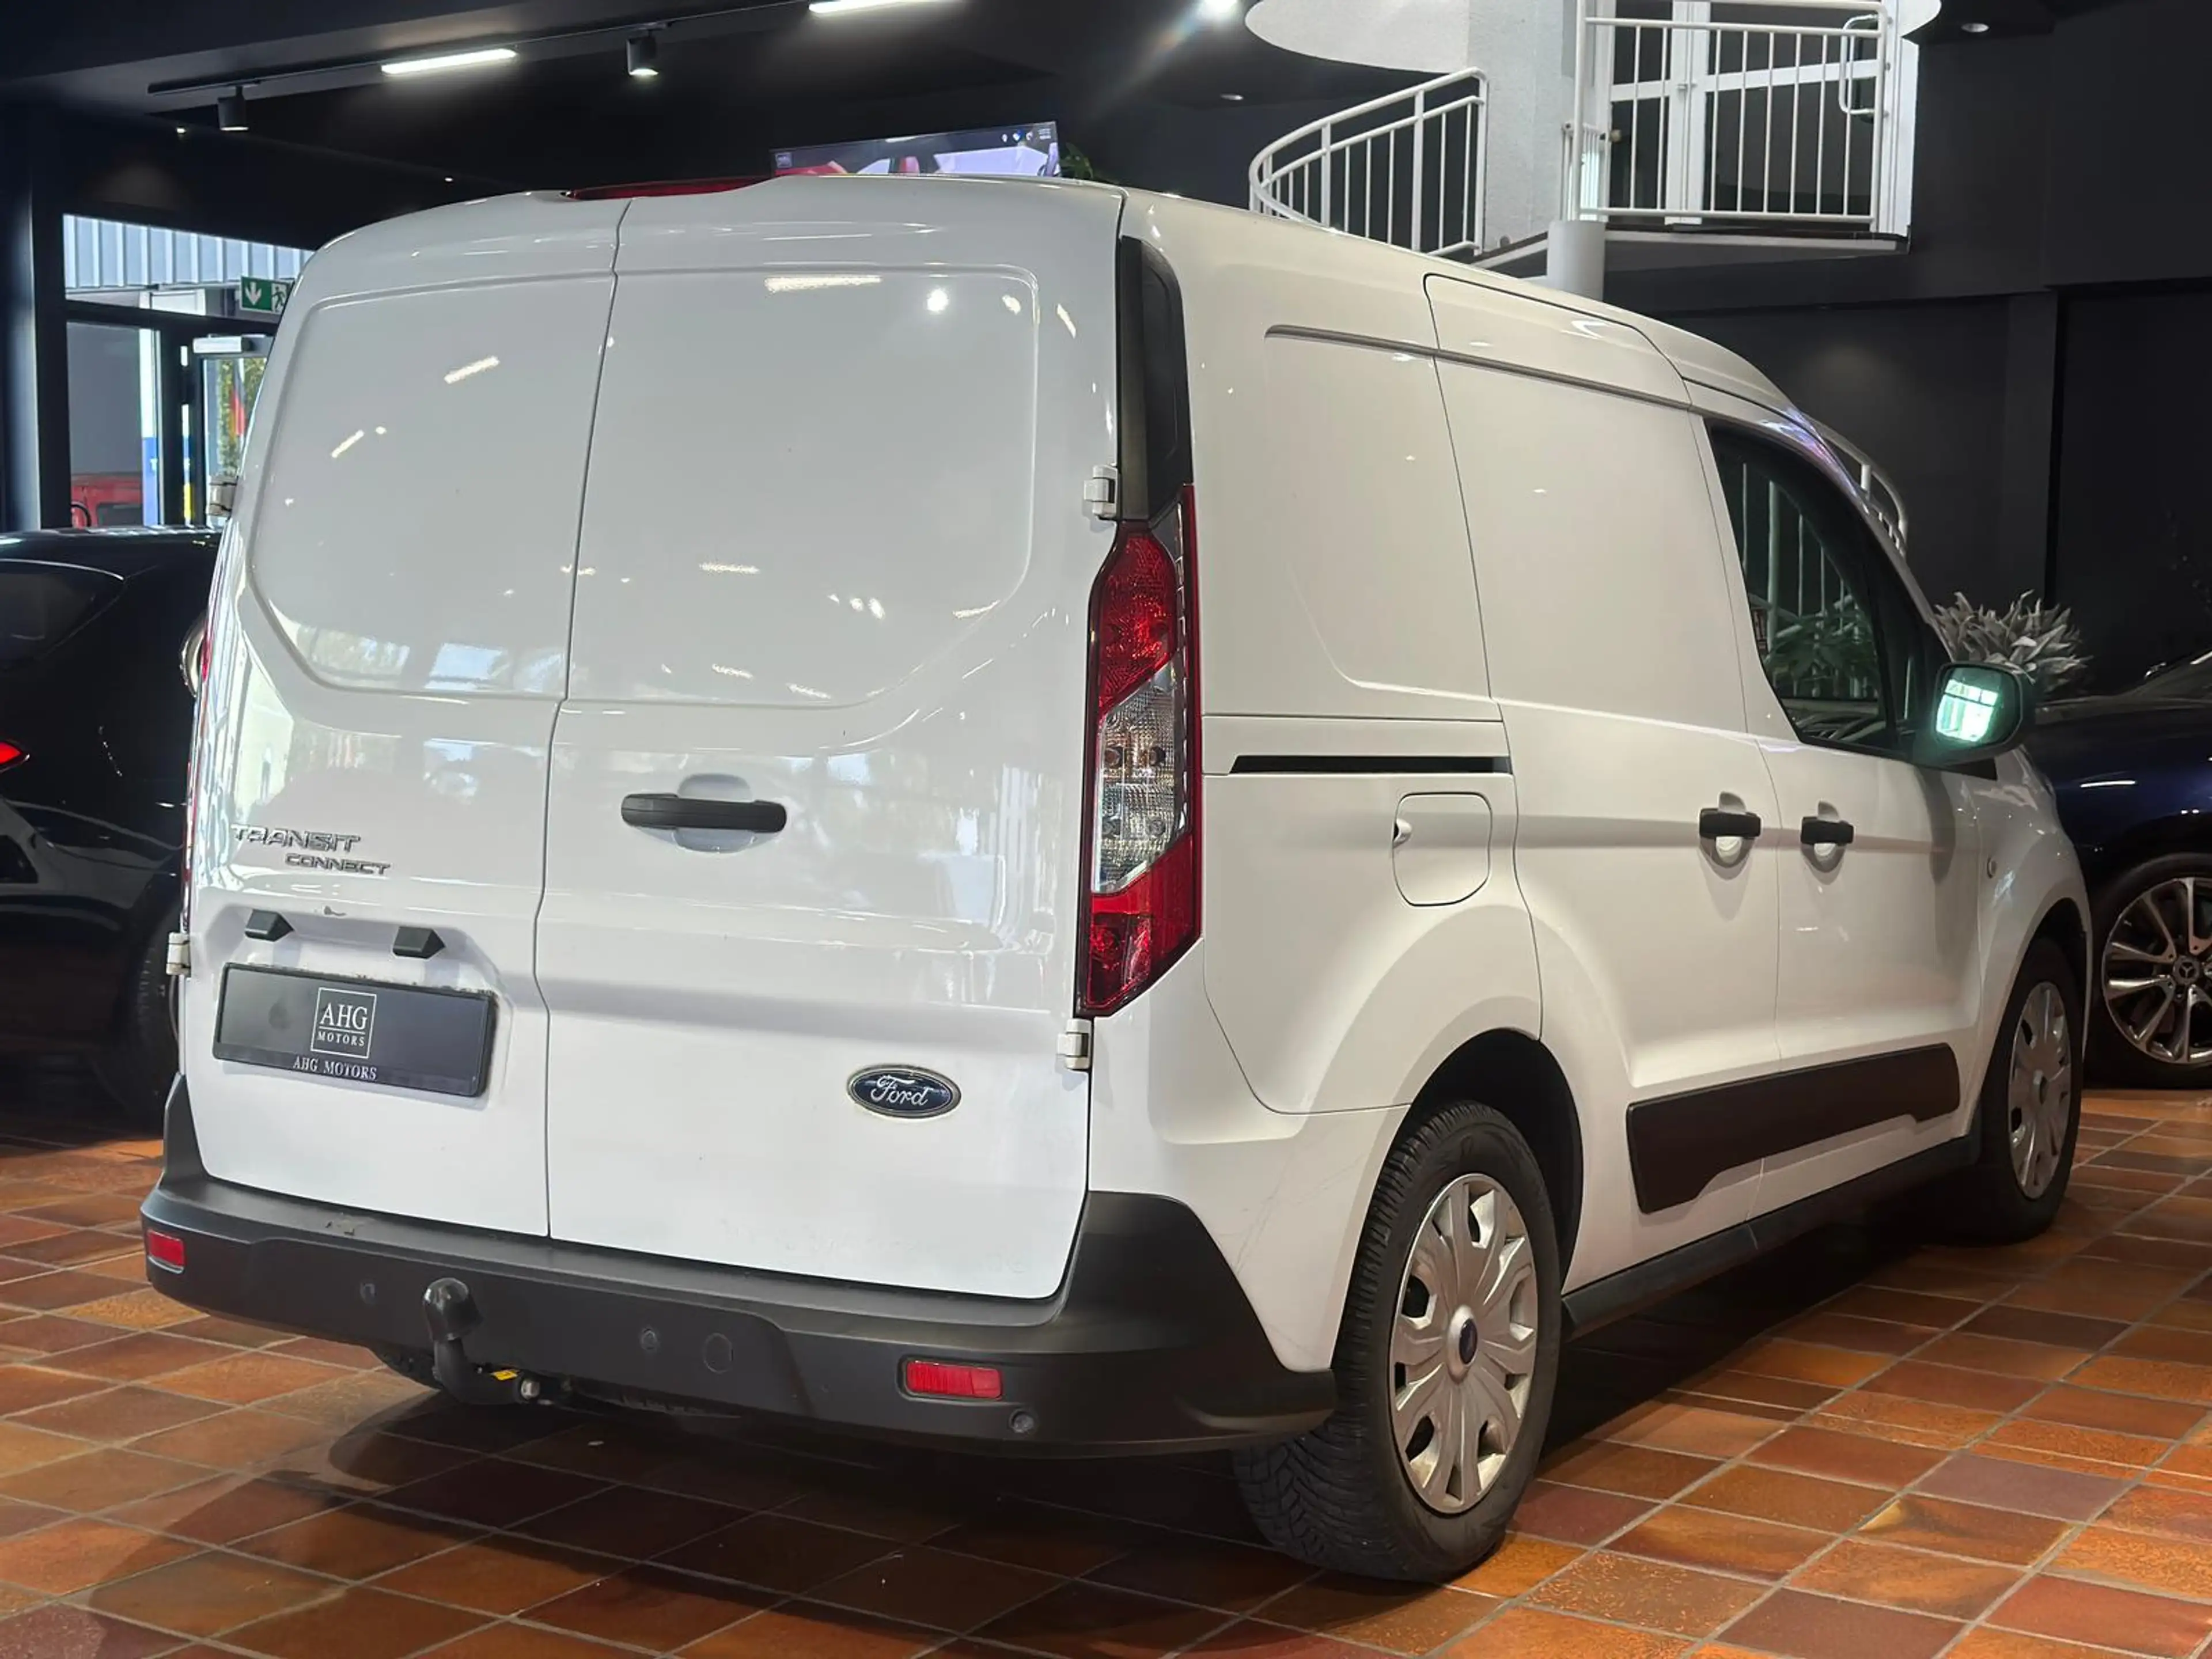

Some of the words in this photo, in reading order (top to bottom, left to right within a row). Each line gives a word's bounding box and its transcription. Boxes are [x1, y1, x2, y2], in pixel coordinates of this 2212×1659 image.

[230, 824, 361, 853] TRANSIT
[285, 853, 391, 875] CONNECT
[320, 1002, 368, 1030] AHG
[317, 1031, 365, 1047] MOTORS
[293, 1055, 319, 1072] AHG
[323, 1060, 378, 1081] MOTORS
[870, 1074, 934, 1107] Ford
